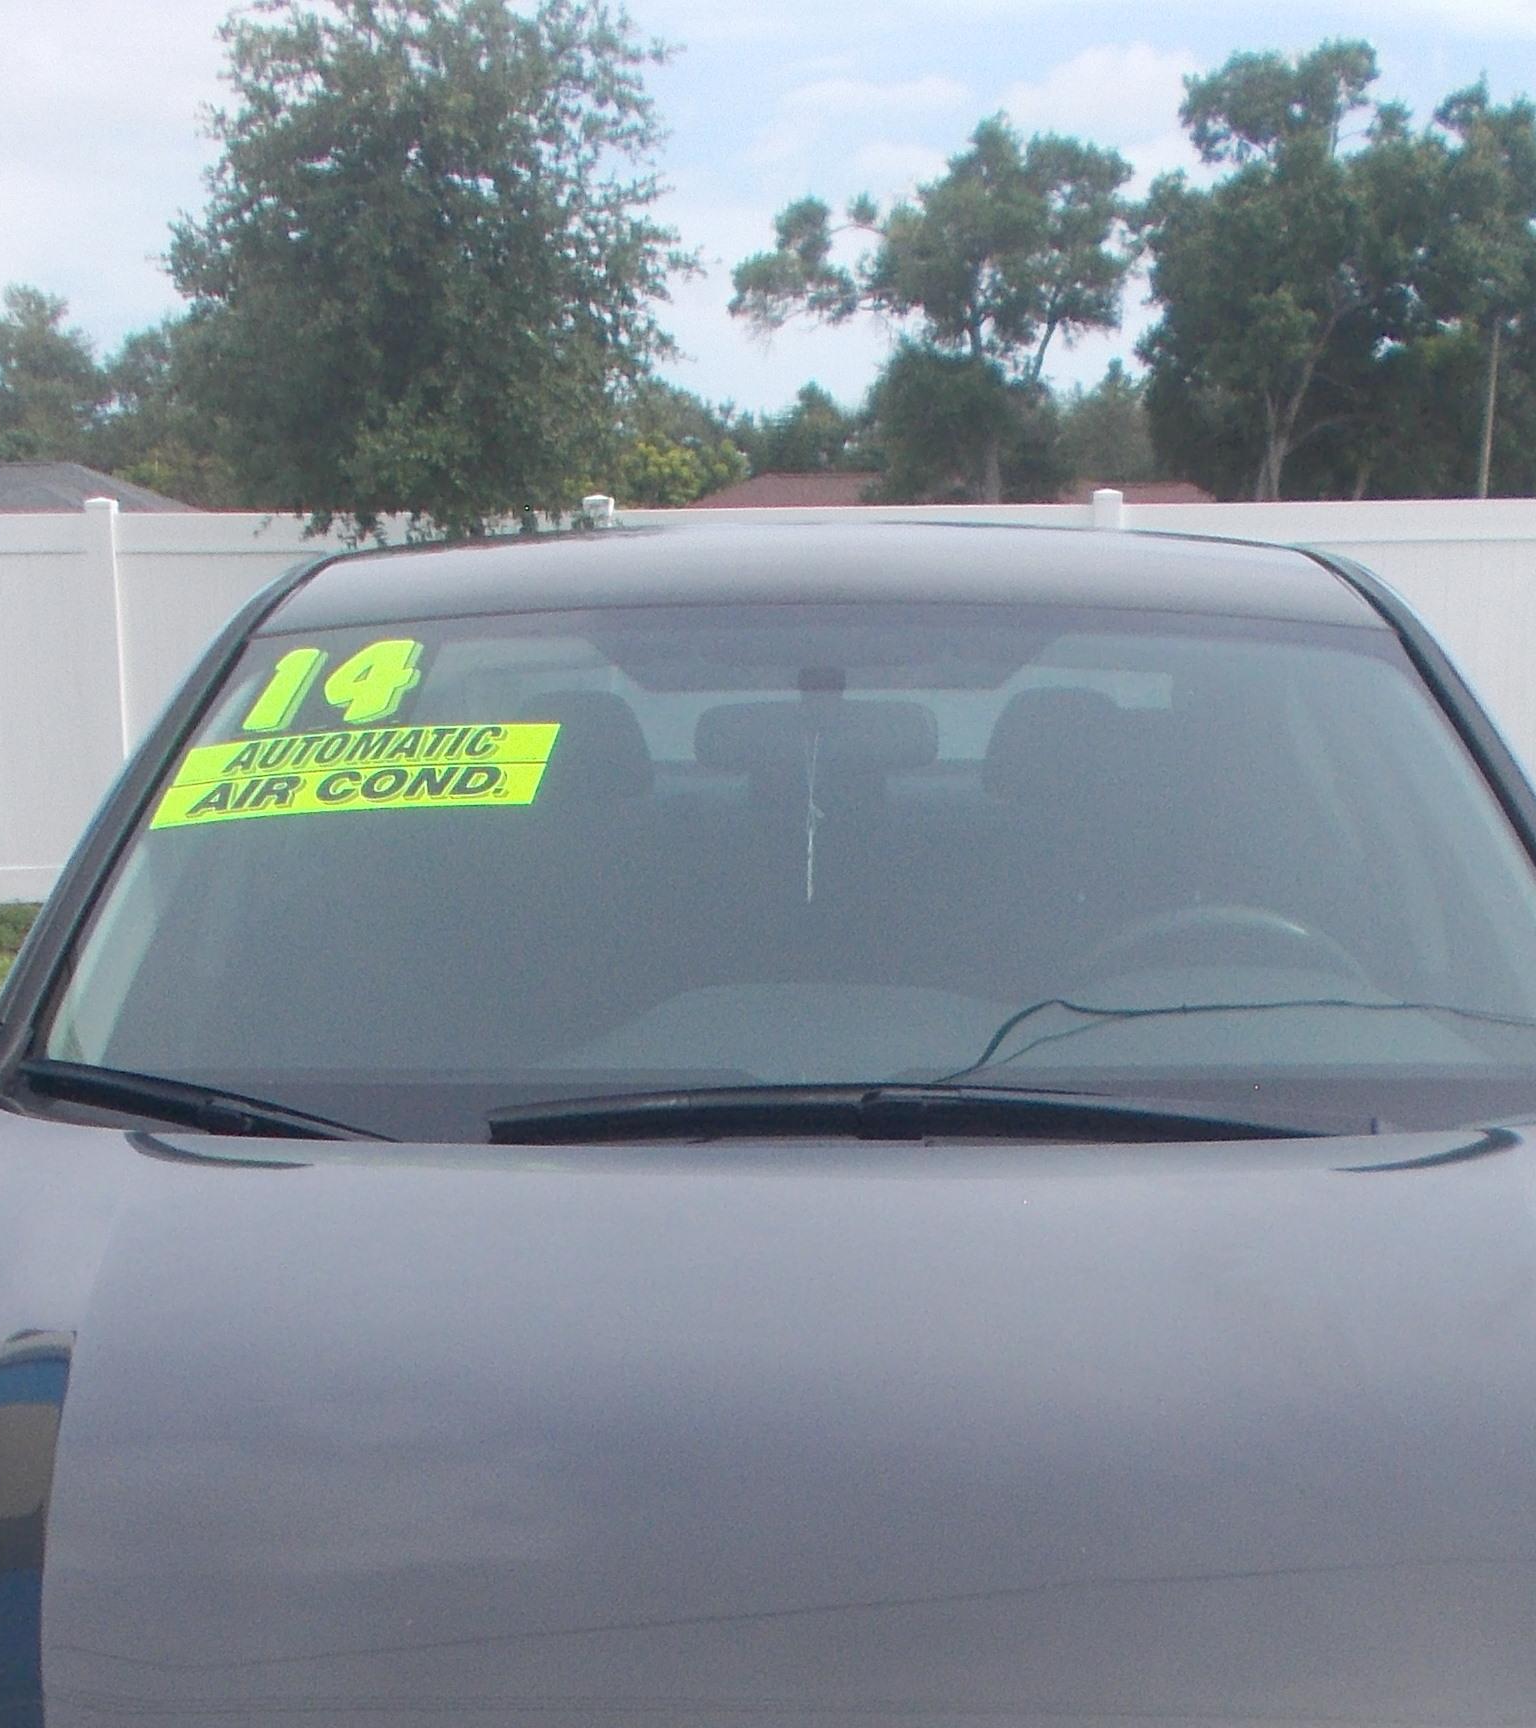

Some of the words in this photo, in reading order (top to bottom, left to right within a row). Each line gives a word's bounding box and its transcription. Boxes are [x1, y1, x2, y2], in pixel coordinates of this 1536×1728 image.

[242, 640, 424, 731] 14
[222, 726, 507, 775] AUTOMATIC
[185, 775, 306, 819] AIR
[315, 765, 510, 806] COND.
